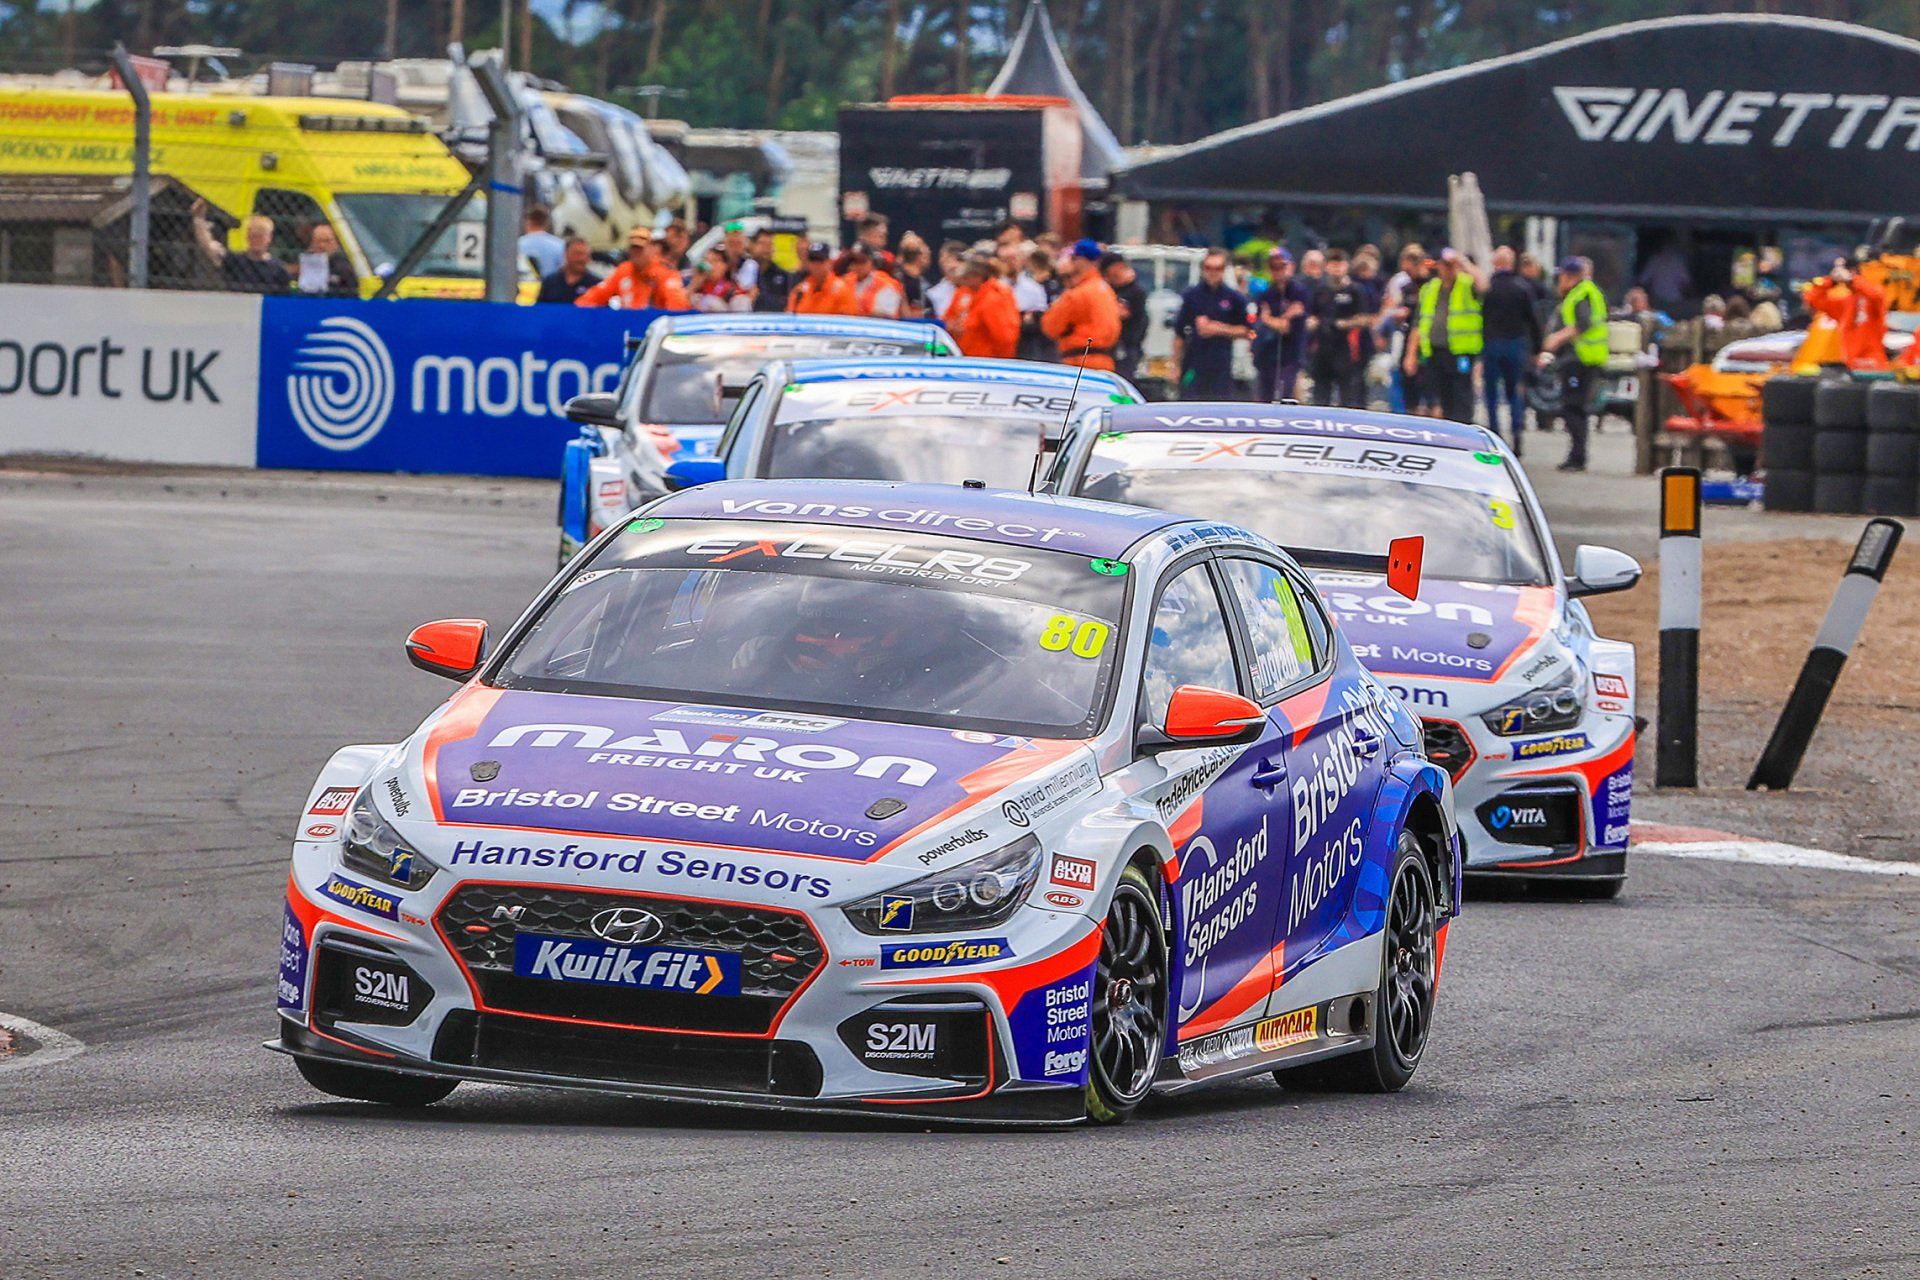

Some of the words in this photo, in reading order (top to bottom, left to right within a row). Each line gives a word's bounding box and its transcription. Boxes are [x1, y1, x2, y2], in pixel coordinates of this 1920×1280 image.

[94, 107, 168, 124] MEDIAL
[463, 234, 480, 258] 2
[142, 348, 220, 404] UK
[846, 386, 1077, 413] EXCELR8
[1168, 438, 1436, 472] EXCELR8
[1304, 461, 1428, 477] MOTORSPORT
[1489, 500, 1514, 530] 3
[686, 534, 1032, 581] EXCELR8
[850, 563, 1010, 588] MOTORSPORT
[1039, 614, 1109, 659] 80
[1392, 646, 1493, 671] Motors
[1519, 736, 1585, 757] GOODYEAR
[588, 752, 748, 776] FREIGHT
[752, 766, 811, 784] UK
[383, 776, 414, 818] powerbulbs
[1019, 785, 1046, 812] third
[451, 787, 597, 811] Bristol
[606, 792, 741, 823] Street
[750, 808, 880, 848] Motors
[1511, 807, 1547, 824] VITA
[917, 826, 989, 866] powerbulbs
[449, 841, 646, 873] Hansford
[656, 851, 832, 898] Sensors
[1053, 868, 1092, 885] GLYM
[1056, 859, 1093, 874] AUTO
[1190, 814, 1269, 922] Hansford
[1287, 817, 1362, 936] Motors
[327, 880, 392, 913] GOODYEAR
[1051, 894, 1078, 905] ABS
[1184, 881, 1258, 968] Sensors
[852, 958, 876, 967] TOW
[893, 942, 1000, 964] GOODYEAR
[354, 966, 409, 1003] S2M
[1046, 981, 1089, 1007] Bristol
[1047, 1001, 1088, 1026] Street
[866, 1022, 937, 1051] S2M
[1047, 1023, 1087, 1043] Motors
[1260, 1010, 1313, 1050] AUTOCAR
[1044, 1047, 1087, 1075] Forge
